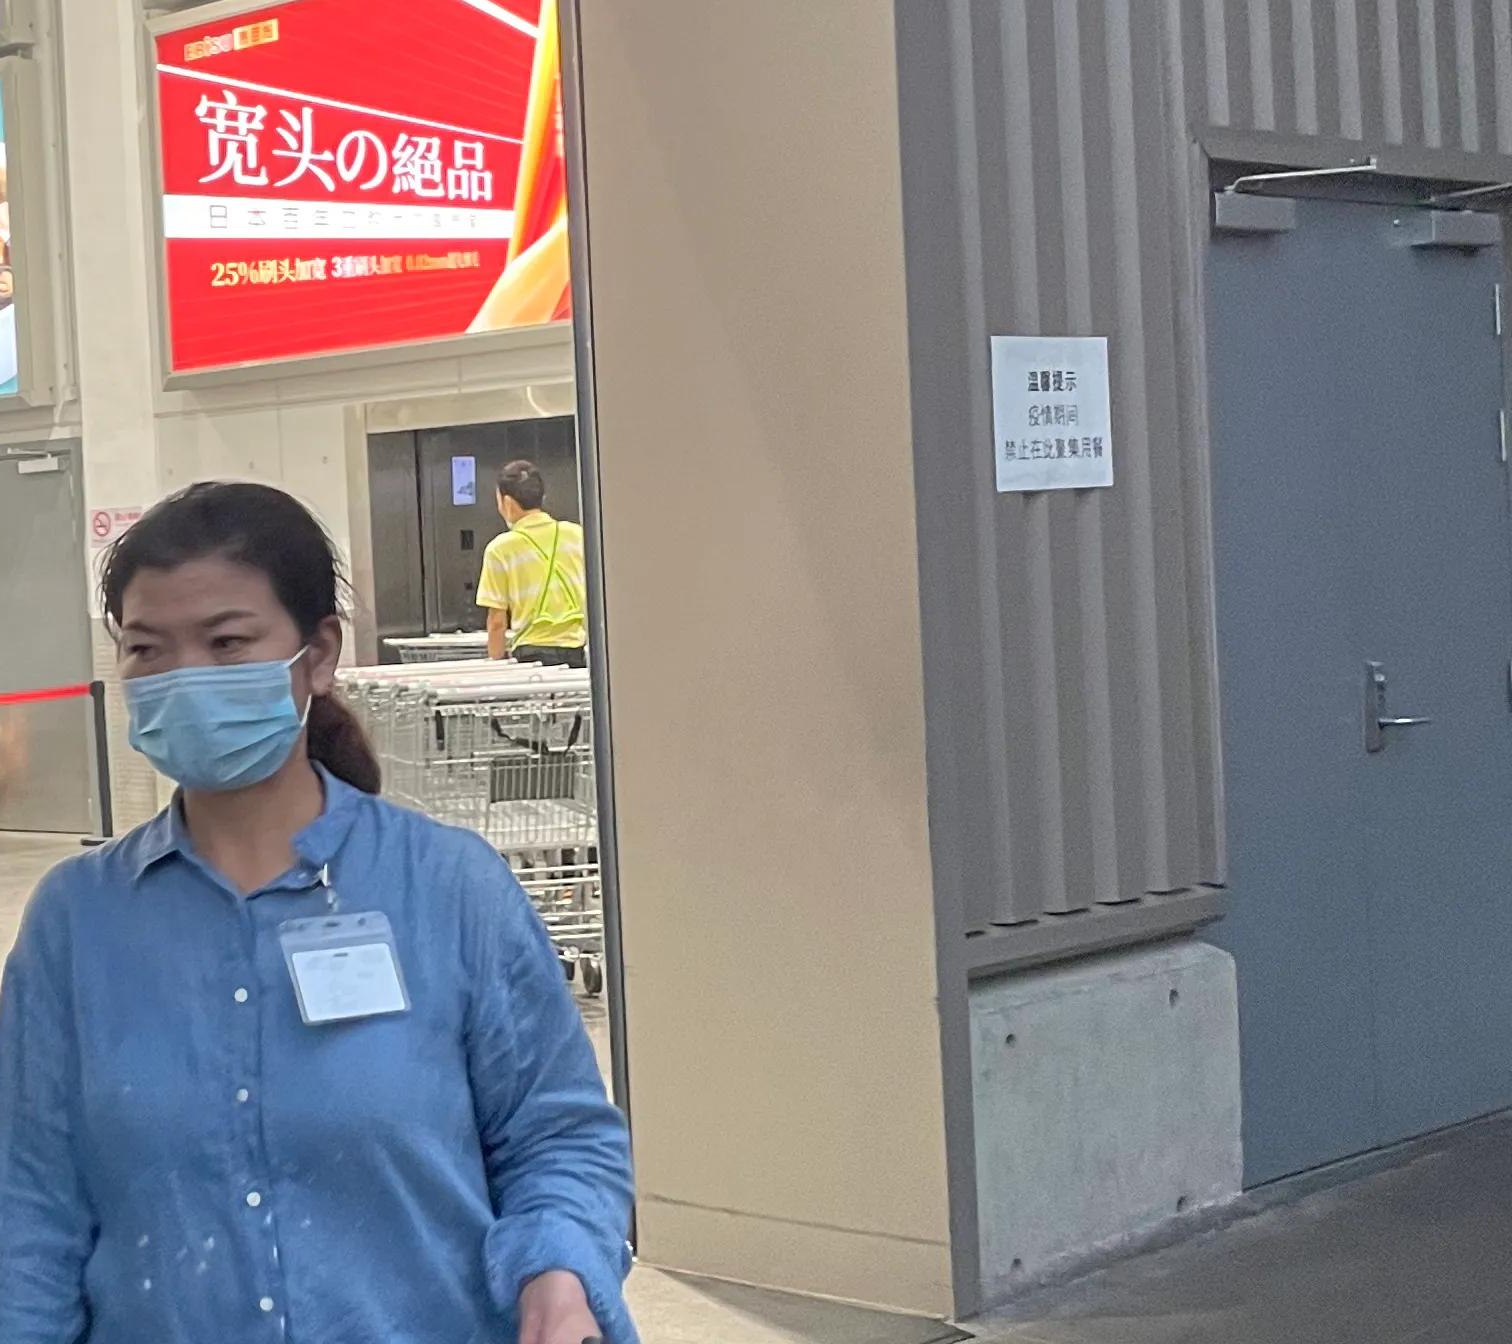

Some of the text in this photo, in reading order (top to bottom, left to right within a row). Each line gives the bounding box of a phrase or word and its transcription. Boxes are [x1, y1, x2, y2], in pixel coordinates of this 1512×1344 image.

[1027, 370, 1077, 392] 温馨提示
[1028, 404, 1078, 427] 疫情期间
